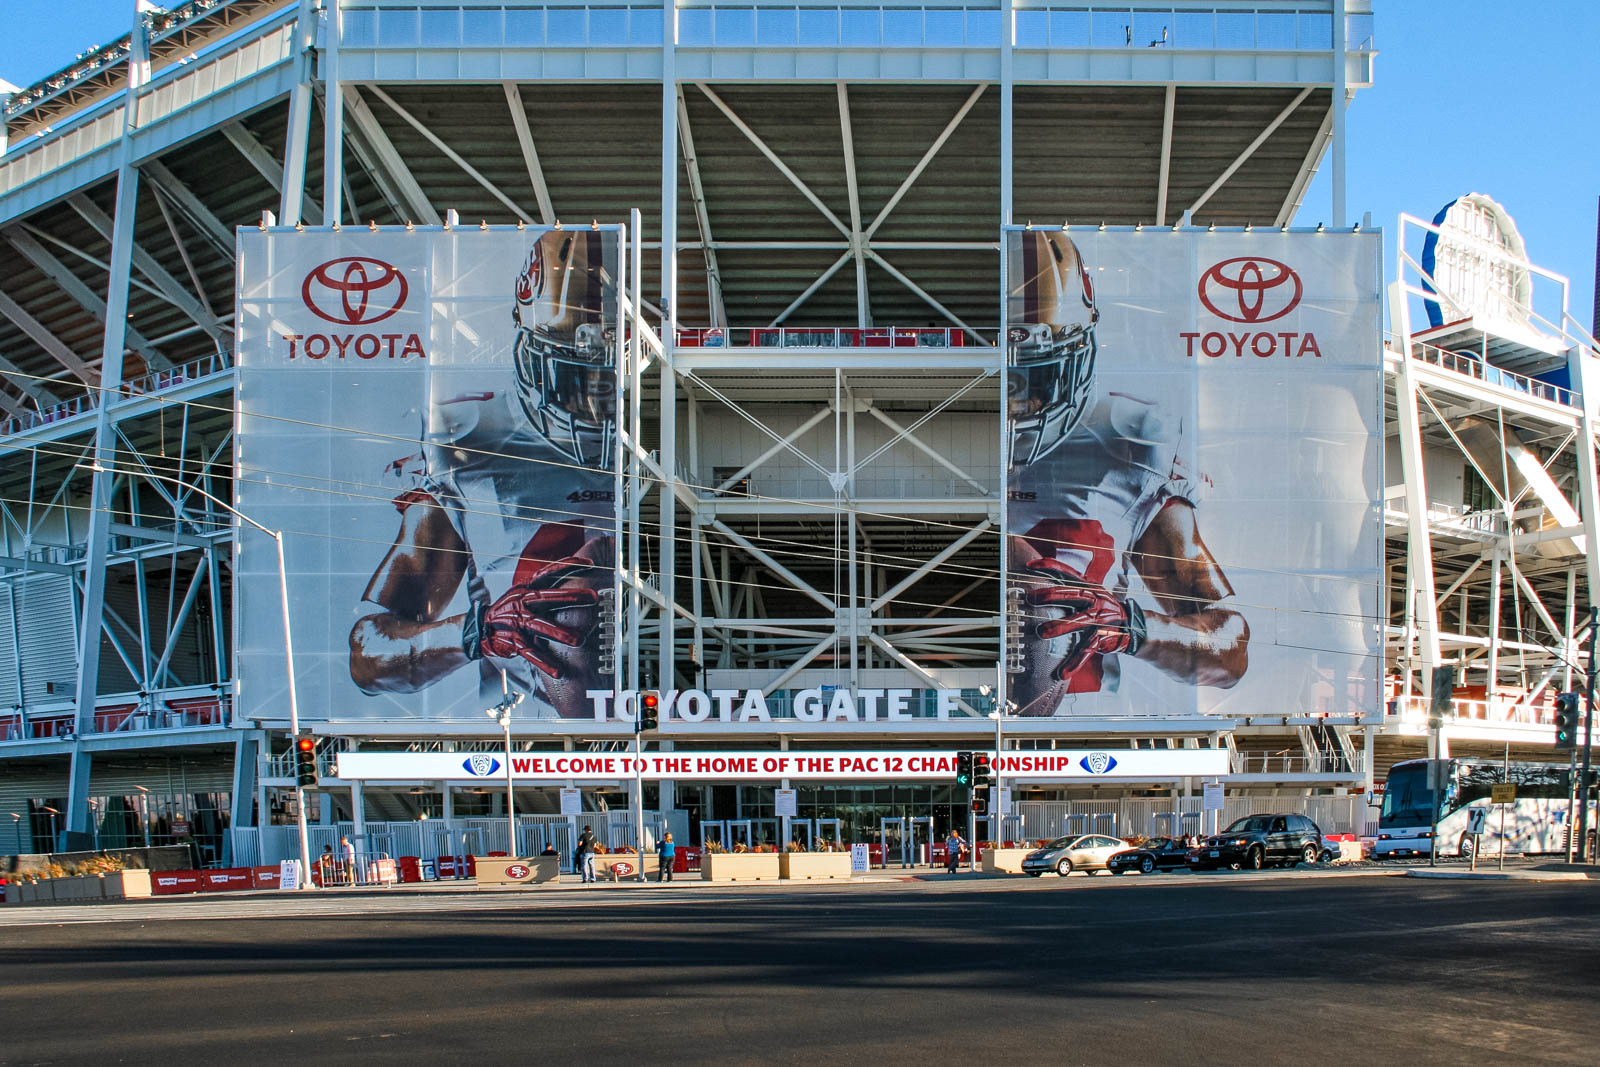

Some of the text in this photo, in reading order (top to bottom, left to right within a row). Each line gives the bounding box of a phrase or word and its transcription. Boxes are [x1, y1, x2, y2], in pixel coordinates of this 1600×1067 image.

[283, 333, 427, 360] TOYOTA
[1179, 331, 1322, 358] TOYOTA
[793, 689, 912, 722] GATE
[938, 689, 961, 722] F
[511, 757, 1069, 774] WELCOME TO THE HOME OF THE PAC 12 CHAONSHIP
